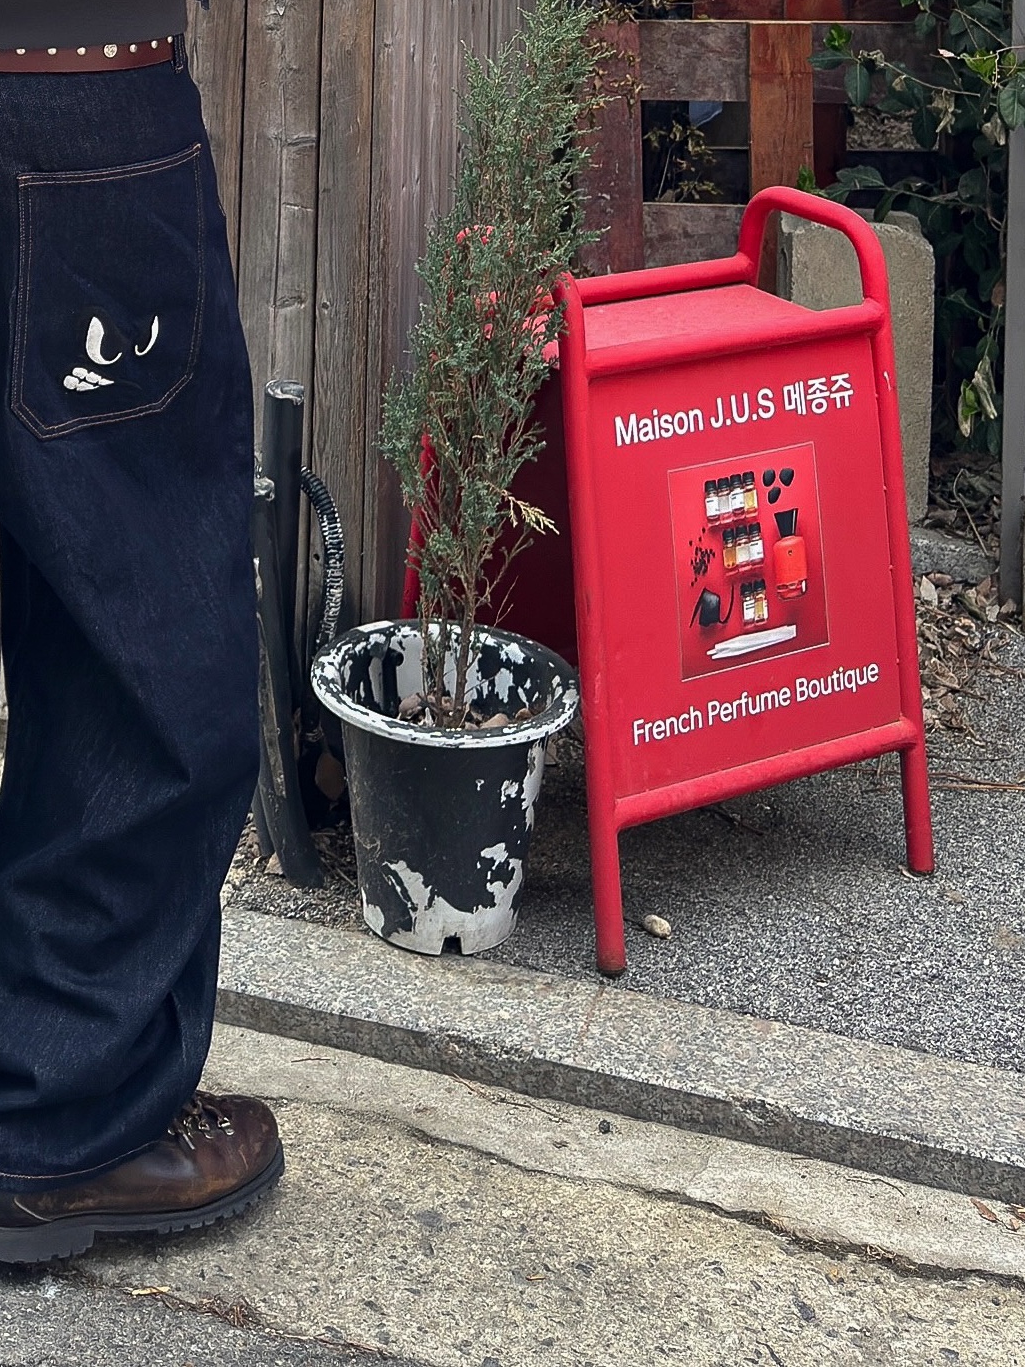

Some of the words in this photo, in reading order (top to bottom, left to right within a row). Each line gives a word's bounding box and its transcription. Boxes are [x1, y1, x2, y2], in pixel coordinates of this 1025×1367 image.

[614, 408, 704, 447] Maison
[710, 387, 775, 429] J.U.S
[782, 373, 854, 417] 메종쥬
[633, 705, 703, 746] French
[707, 687, 791, 726] Perfume
[795, 663, 879, 702] Boutique
